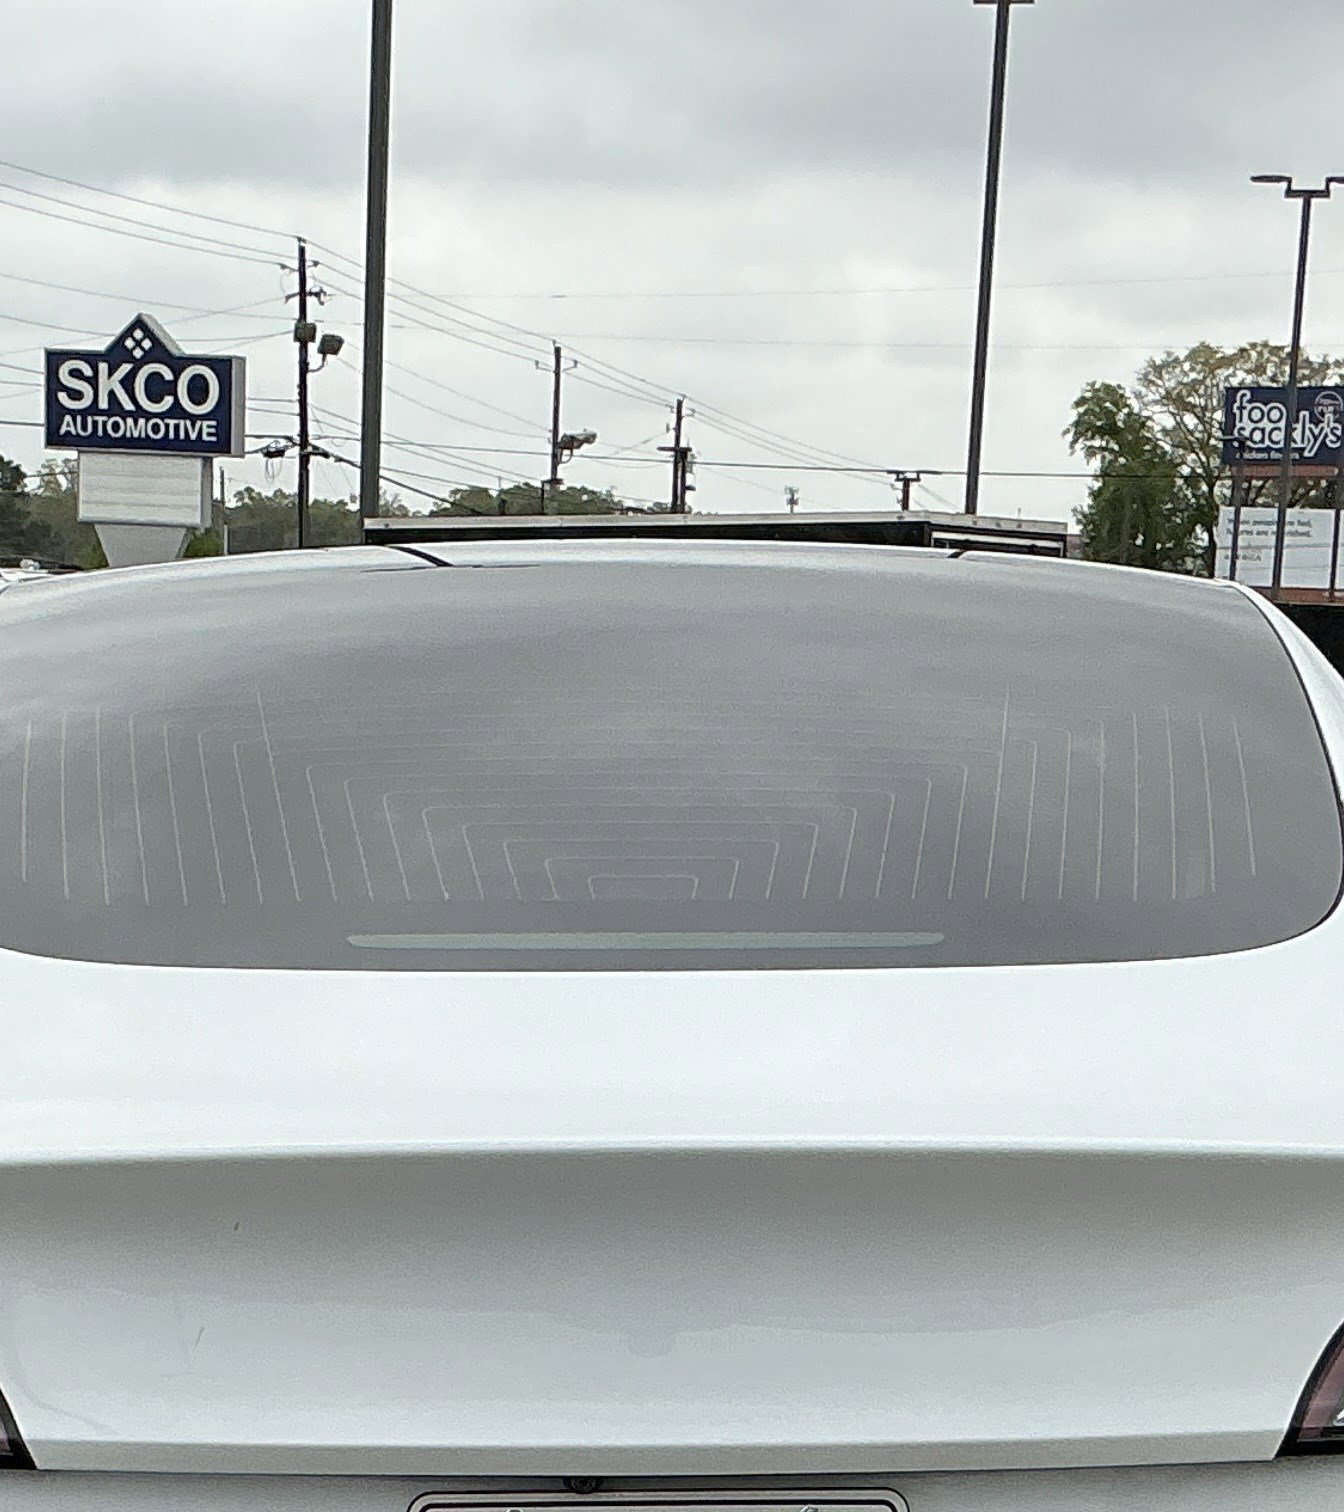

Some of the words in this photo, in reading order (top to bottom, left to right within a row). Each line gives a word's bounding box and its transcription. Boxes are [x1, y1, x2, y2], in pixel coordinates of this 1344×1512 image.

[57, 359, 221, 415] SKCO
[1233, 390, 1286, 424] foo
[59, 414, 218, 441] AUTOMOTIVE
